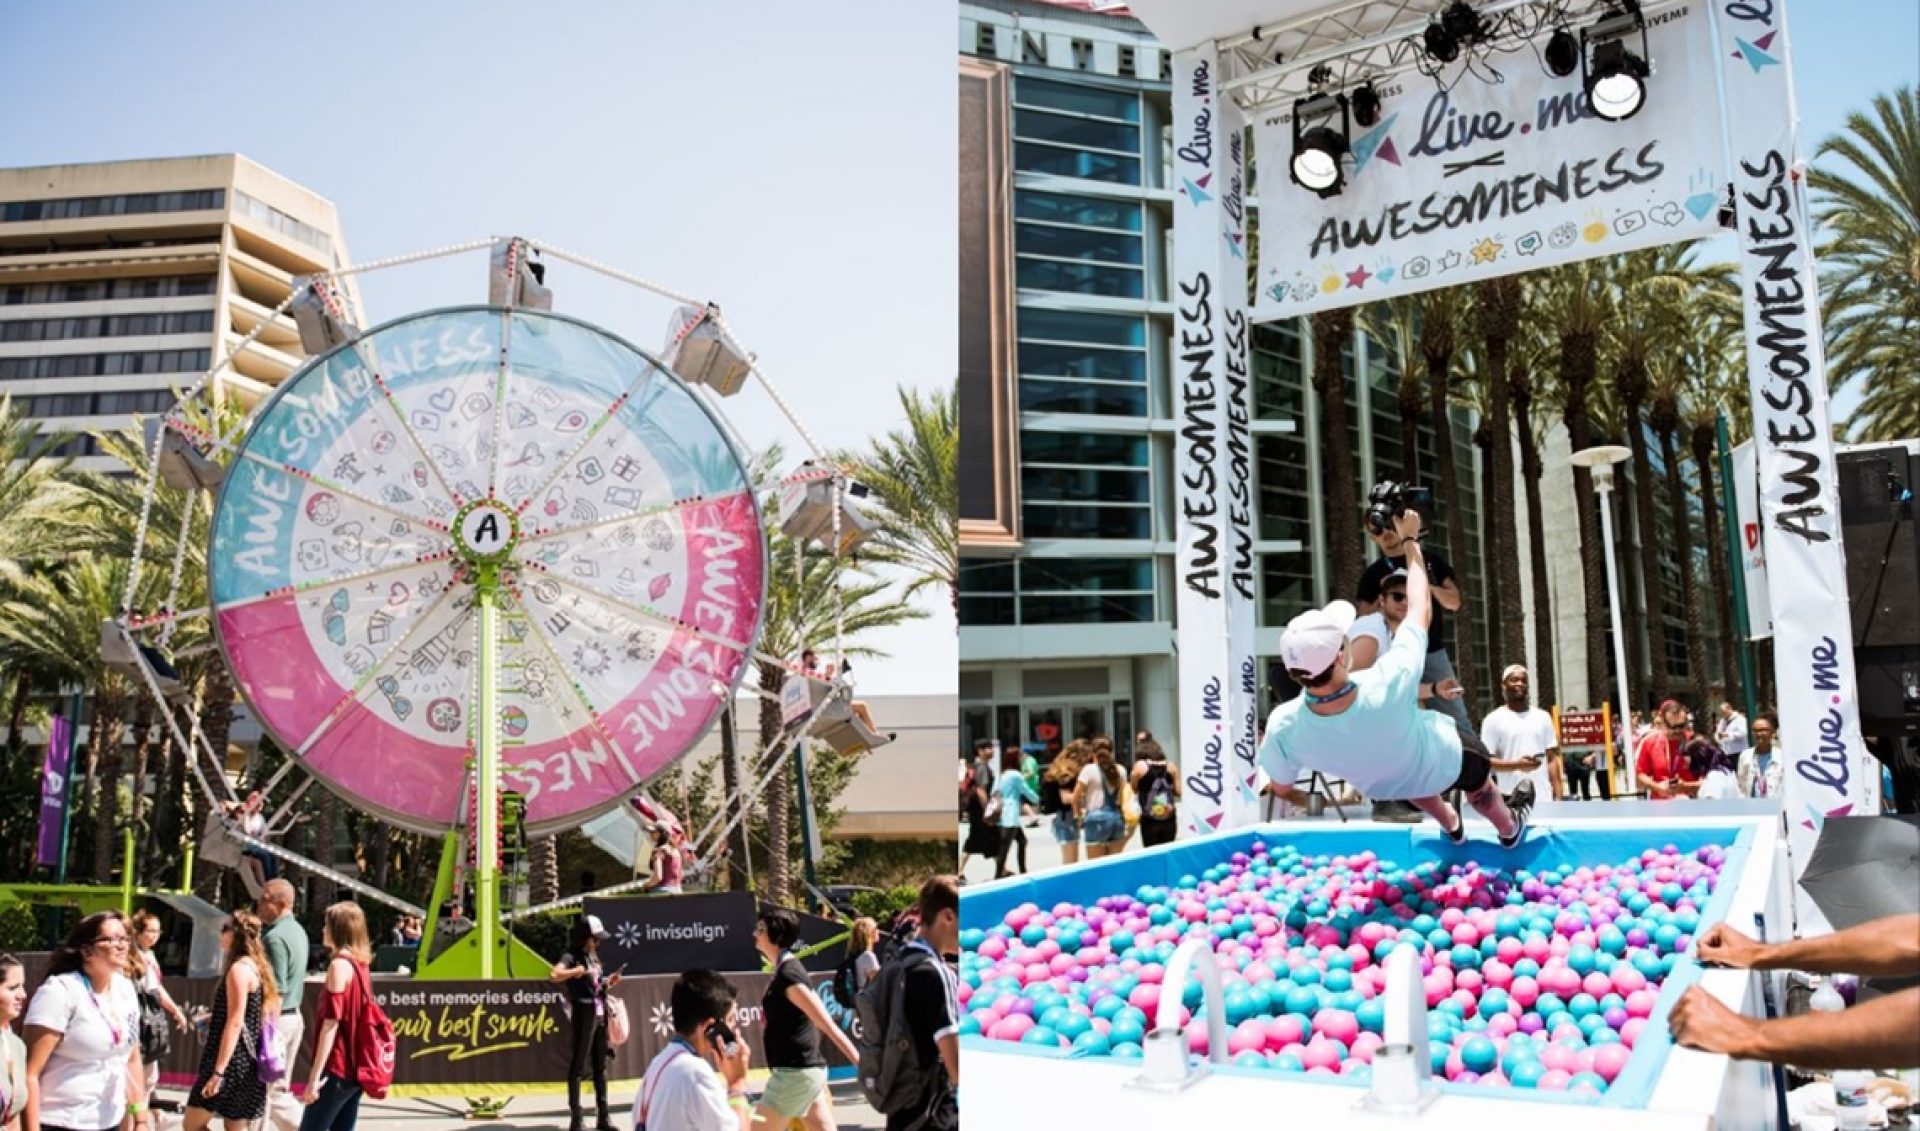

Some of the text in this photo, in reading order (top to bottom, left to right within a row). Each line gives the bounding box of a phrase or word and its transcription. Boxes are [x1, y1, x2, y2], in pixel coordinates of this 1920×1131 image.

[1177, 59, 1212, 169] live.me
[1222, 129, 1243, 229] live.me
[1309, 139, 1665, 258] AWESOMENESS
[1740, 149, 1832, 546] AWESOMENESS
[1179, 270, 1222, 600] AWESOMENESS
[1224, 307, 1255, 601] AWESOMENESS
[474, 513, 499, 544] A
[1187, 675, 1224, 806] live.me
[1234, 655, 1258, 767] live.me
[1796, 635, 1850, 798] live.me
[646, 921, 725, 943] invisalign
[391, 990, 426, 1006] best
[430, 990, 509, 1006] memories
[394, 1003, 560, 1047] our best smile.
